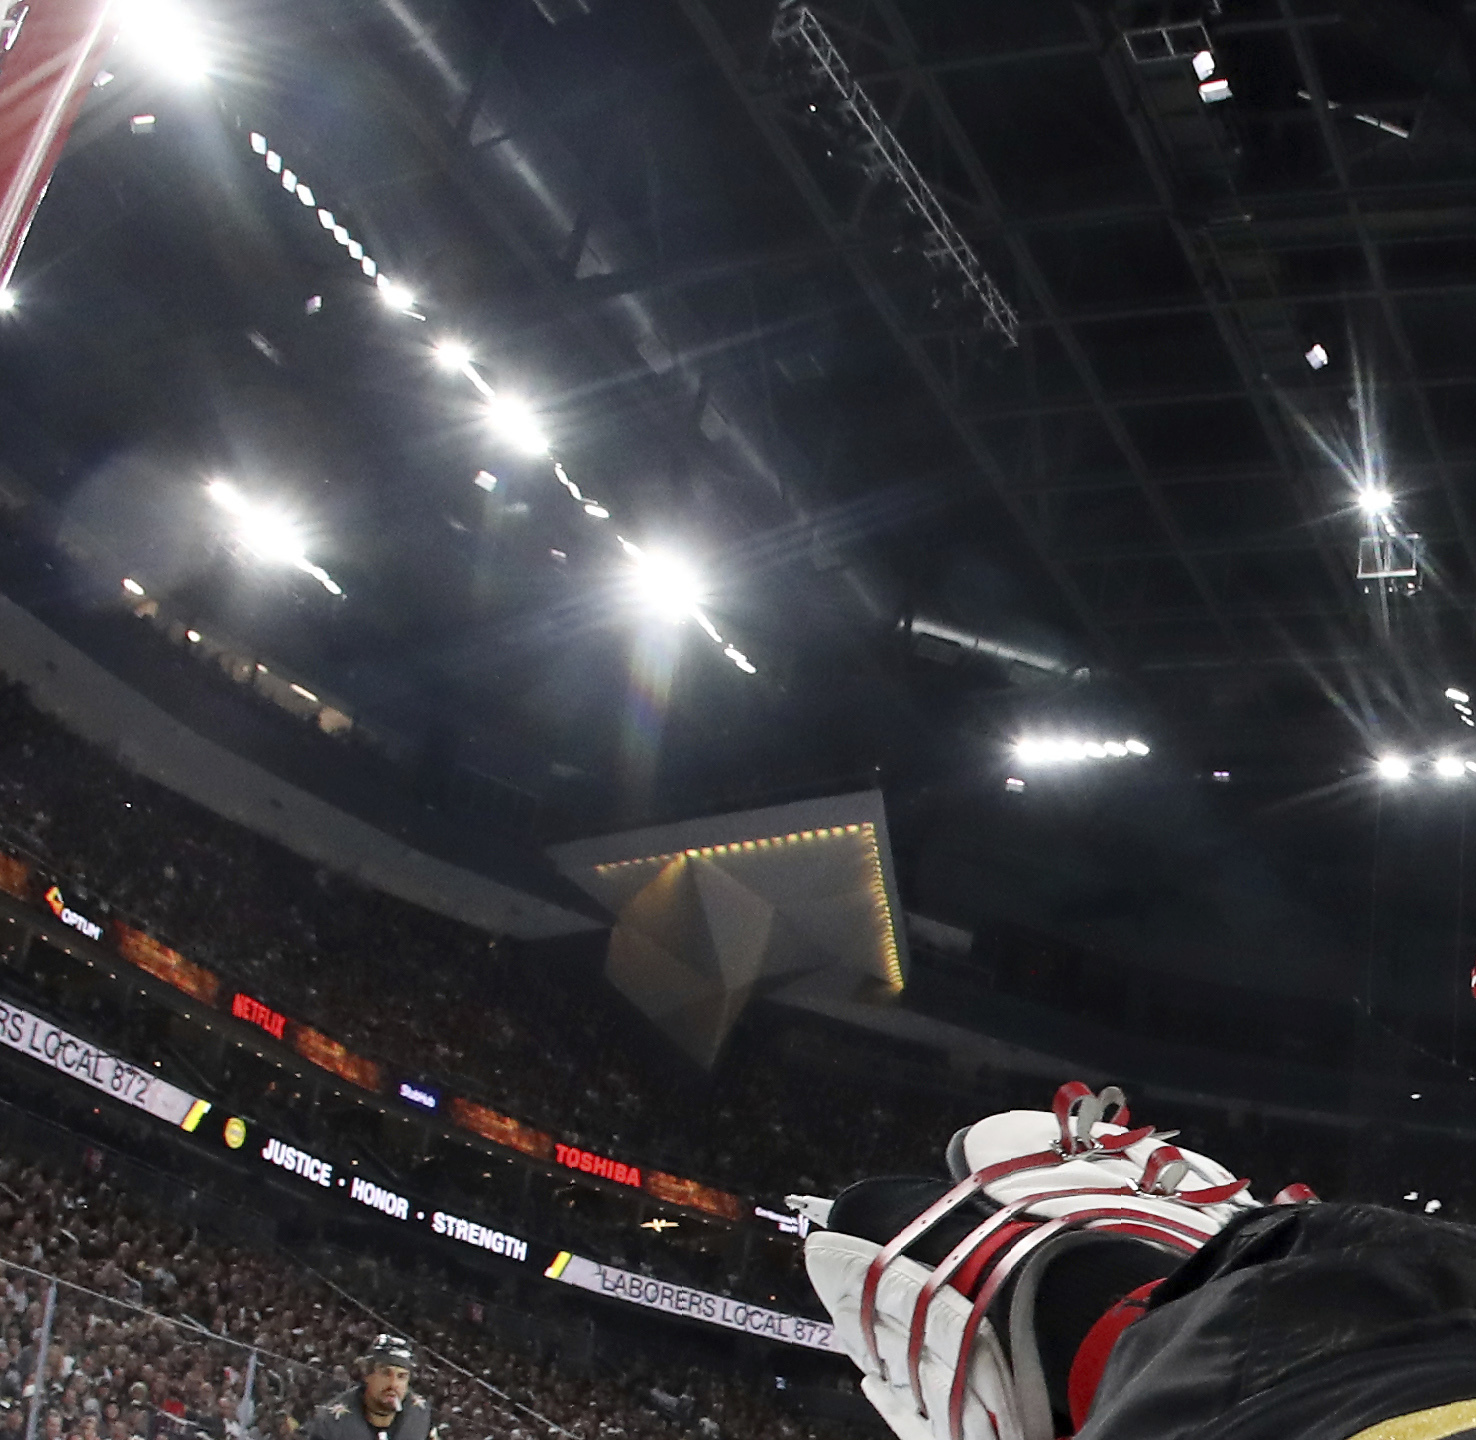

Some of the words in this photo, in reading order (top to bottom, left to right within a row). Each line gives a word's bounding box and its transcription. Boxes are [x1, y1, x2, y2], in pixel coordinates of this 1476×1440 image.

[61, 908, 103, 941] OPTUM
[232, 993, 287, 1040] NETFLIX
[30, 1021, 104, 1084] LOCAL
[111, 1064, 150, 1104] 872
[555, 1142, 641, 1188] TOSHIBA
[262, 1138, 332, 1188] JUSTICE
[351, 1177, 409, 1221] HONOR
[431, 1211, 528, 1262] STRENGTH
[600, 1267, 716, 1318] LABORERS
[721, 1301, 789, 1338] LOCAL
[795, 1322, 831, 1348] 872
